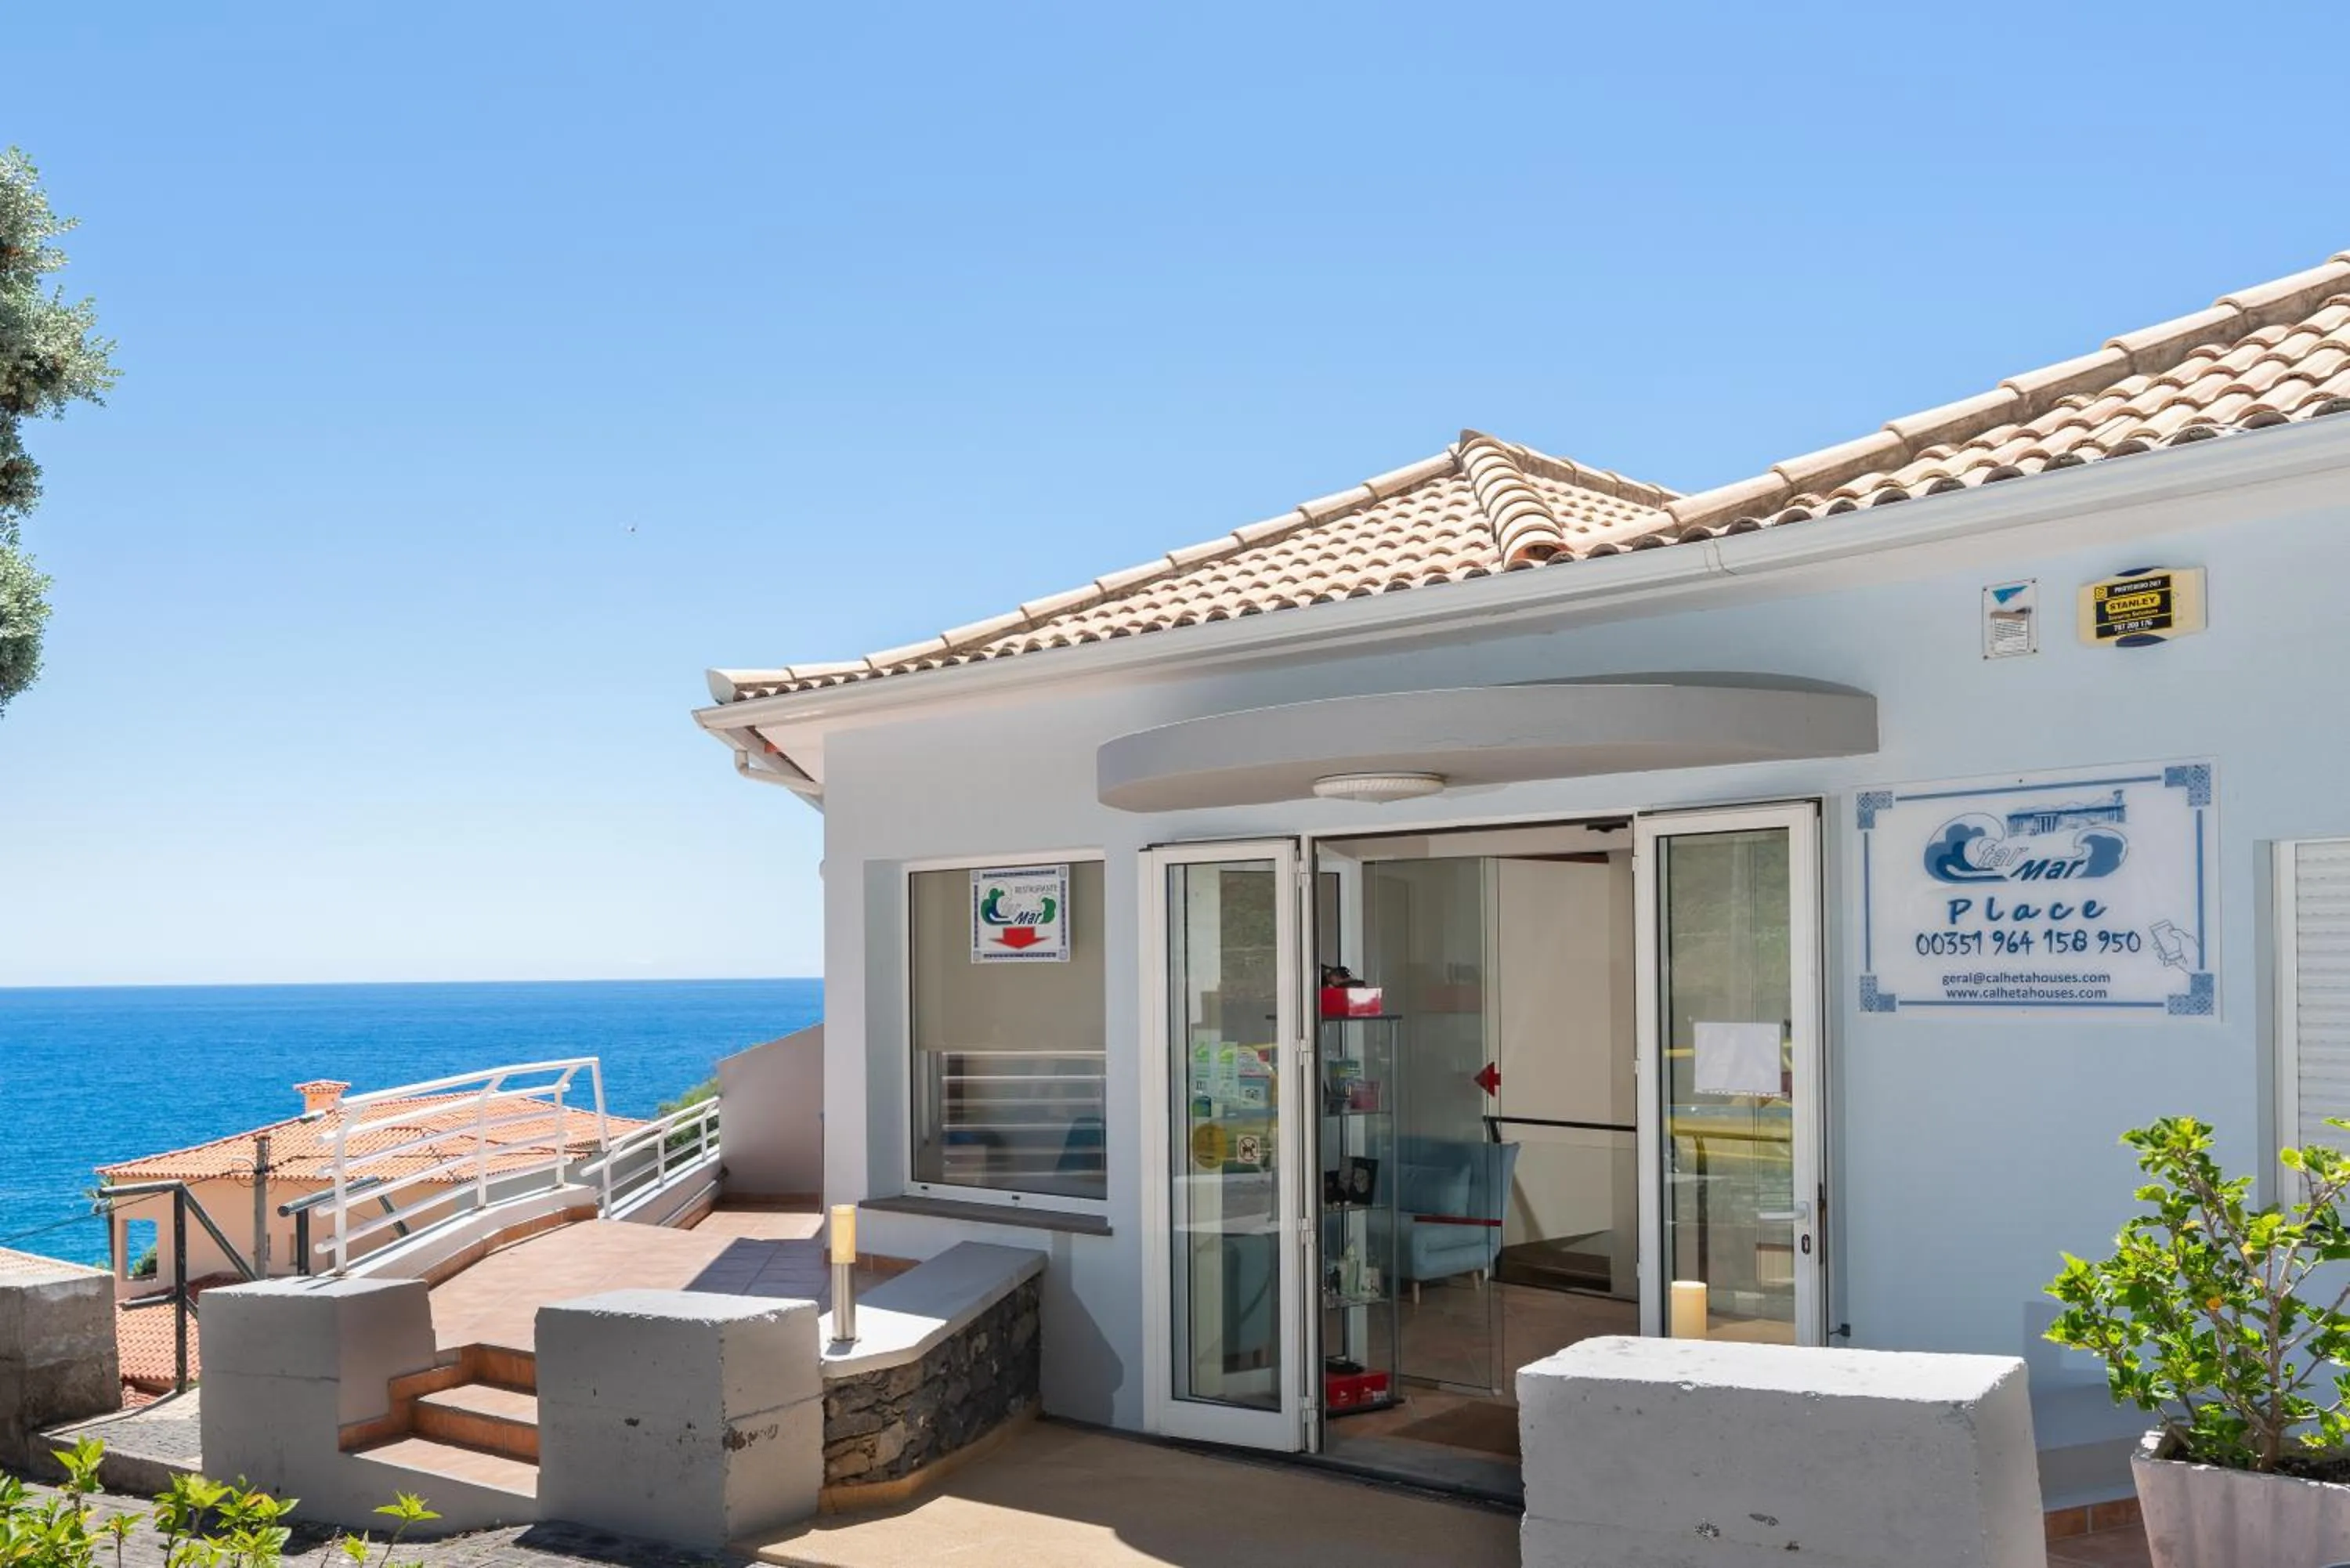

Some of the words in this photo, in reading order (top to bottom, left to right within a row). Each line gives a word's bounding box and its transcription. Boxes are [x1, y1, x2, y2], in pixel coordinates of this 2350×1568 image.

[2109, 596, 2157, 610] STANLEY
[2009, 858, 2087, 881] Mar
[1947, 896, 2107, 925] Place
[1014, 911, 1043, 925] Mar
[1915, 930, 1983, 956] 00351
[1991, 930, 2034, 956] 964
[2042, 928, 2088, 954] 158
[2096, 929, 2142, 954] 950
[1941, 972, 2111, 985] geral@calhetahouses.com
[1945, 986, 2109, 999] www.calhetahouses.com
